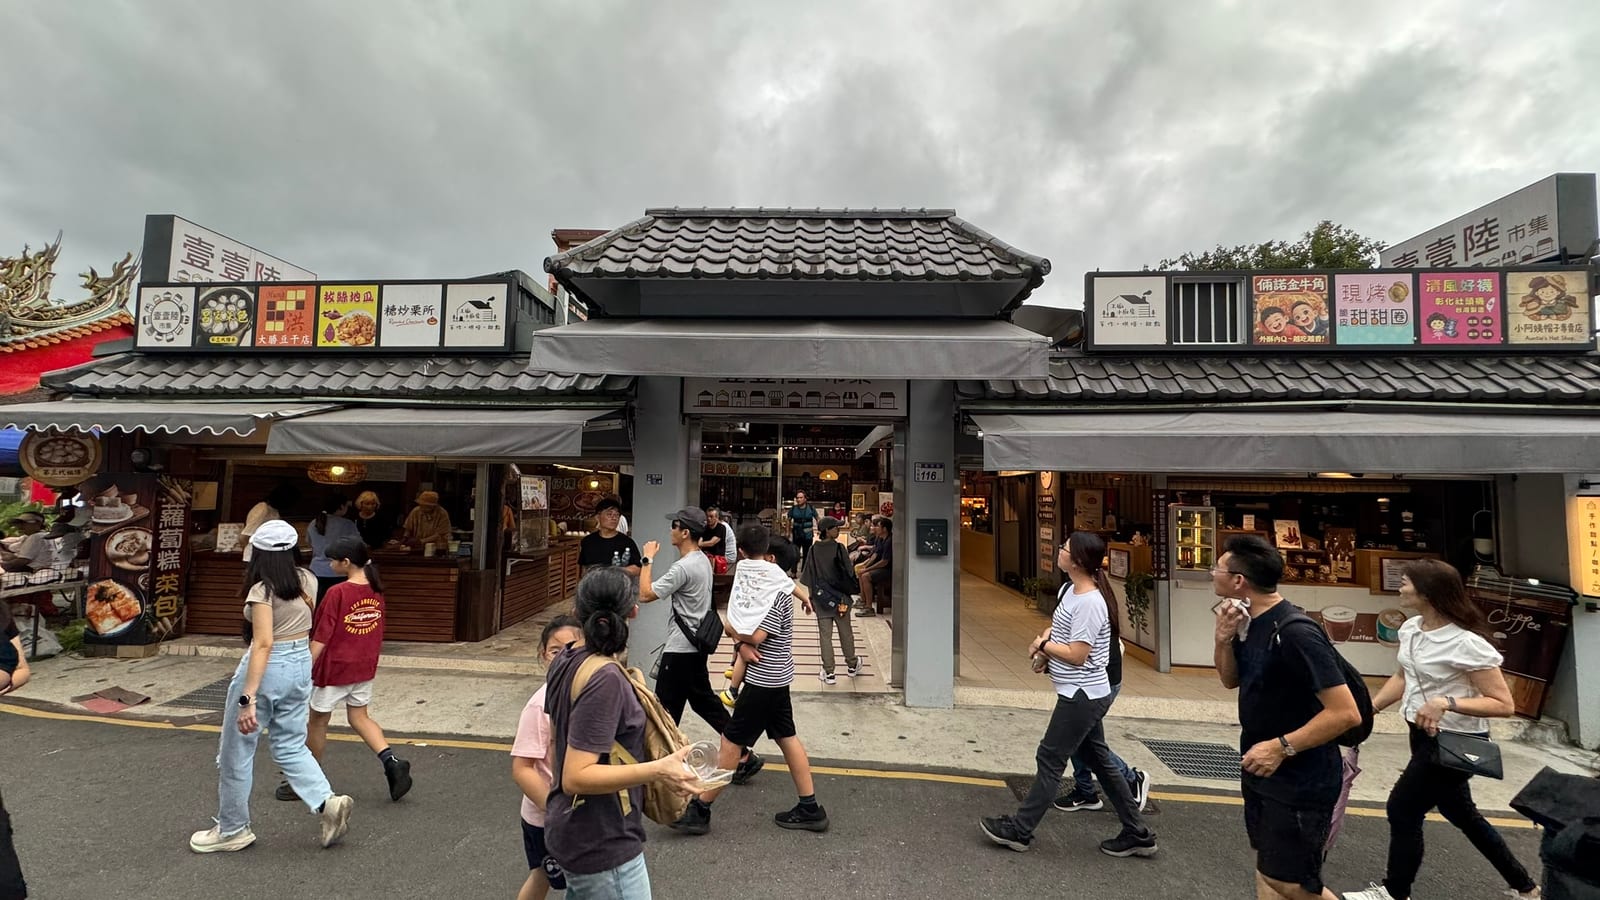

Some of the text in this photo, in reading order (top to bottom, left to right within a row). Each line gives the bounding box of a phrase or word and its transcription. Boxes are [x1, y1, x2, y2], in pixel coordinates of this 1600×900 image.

[1507, 214, 1549, 243] 市集
[1342, 283, 1387, 303] 現烤
[1350, 308, 1409, 326] 甜甜圈
[920, 472, 937, 480] 116
[153, 502, 186, 618] 蘿蔔糕菜包
[1487, 608, 1541, 634] Coffee
